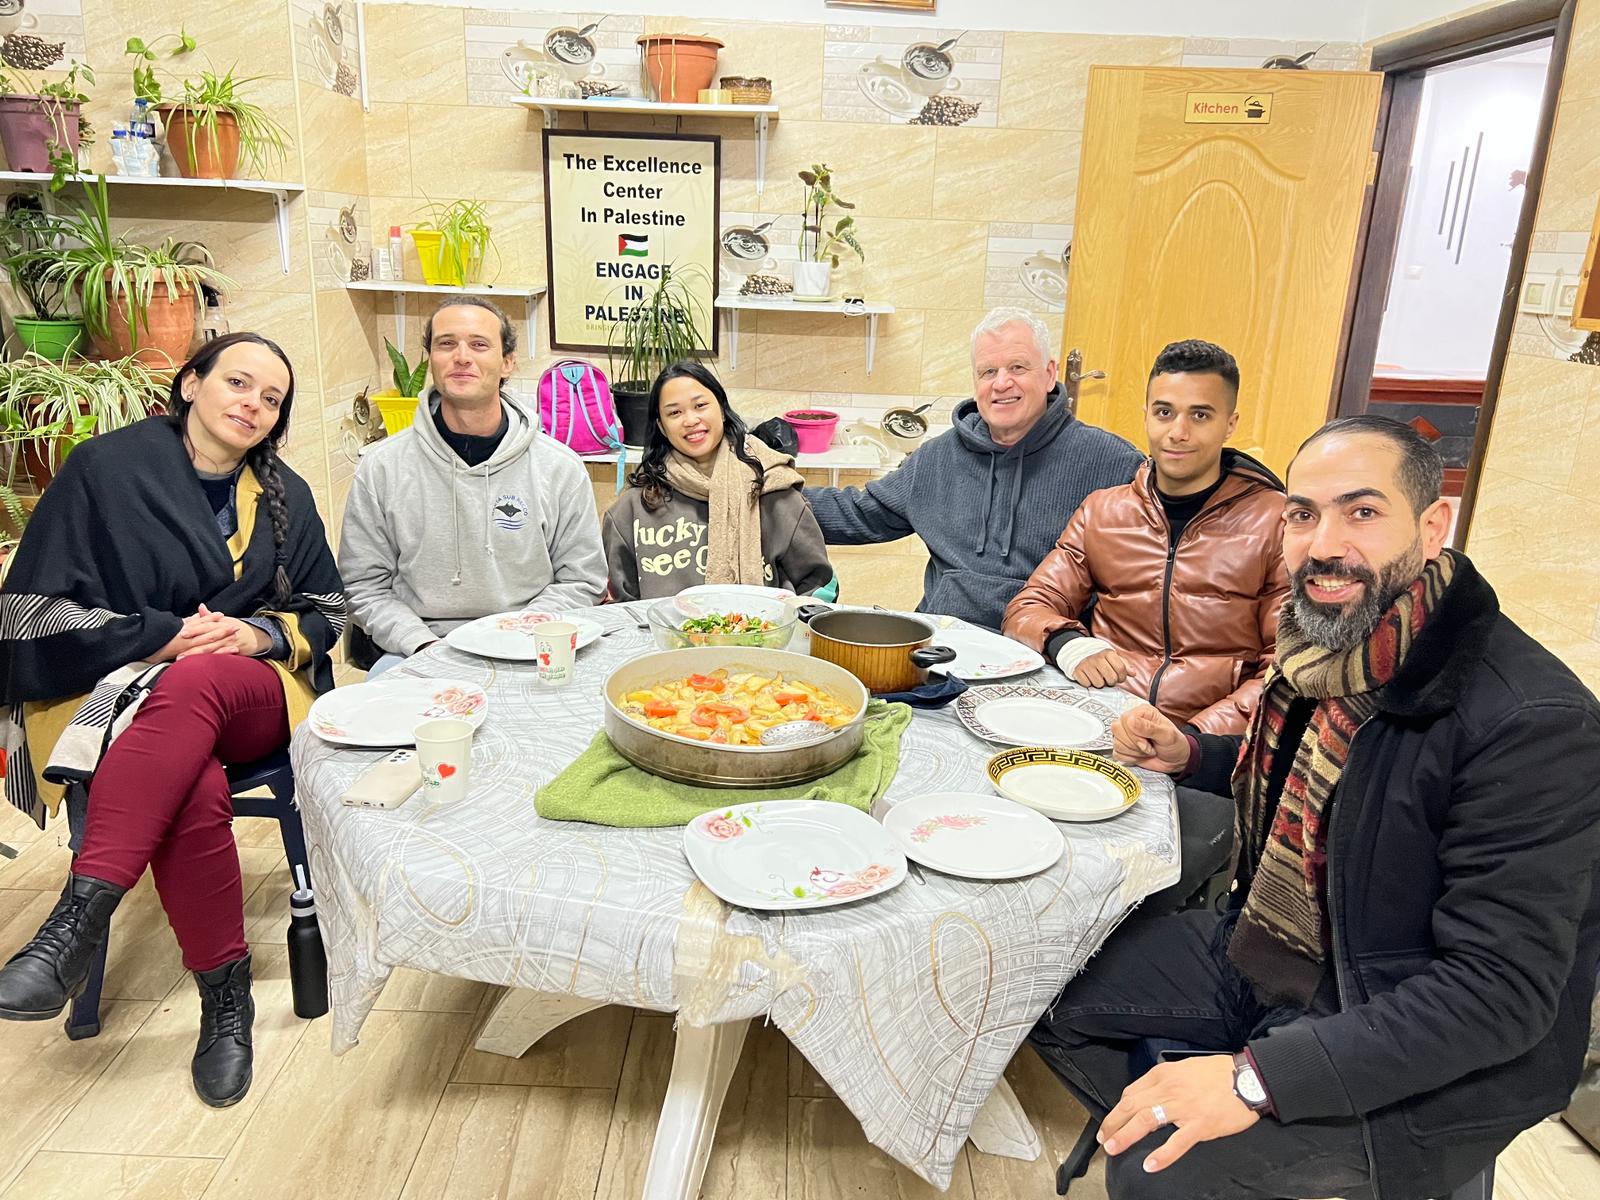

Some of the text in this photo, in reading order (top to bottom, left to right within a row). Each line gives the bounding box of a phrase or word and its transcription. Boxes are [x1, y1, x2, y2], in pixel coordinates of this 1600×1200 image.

[1193, 102, 1238, 114] Kitchen
[563, 153, 702, 175] The Excellence
[603, 181, 663, 199] Center
[581, 207, 686, 227] In Palestine
[596, 262, 671, 280] ENGAGE
[625, 285, 643, 301] IN
[585, 305, 685, 324] PALESTNE
[633, 516, 707, 548] lucky
[641, 548, 692, 576] see
